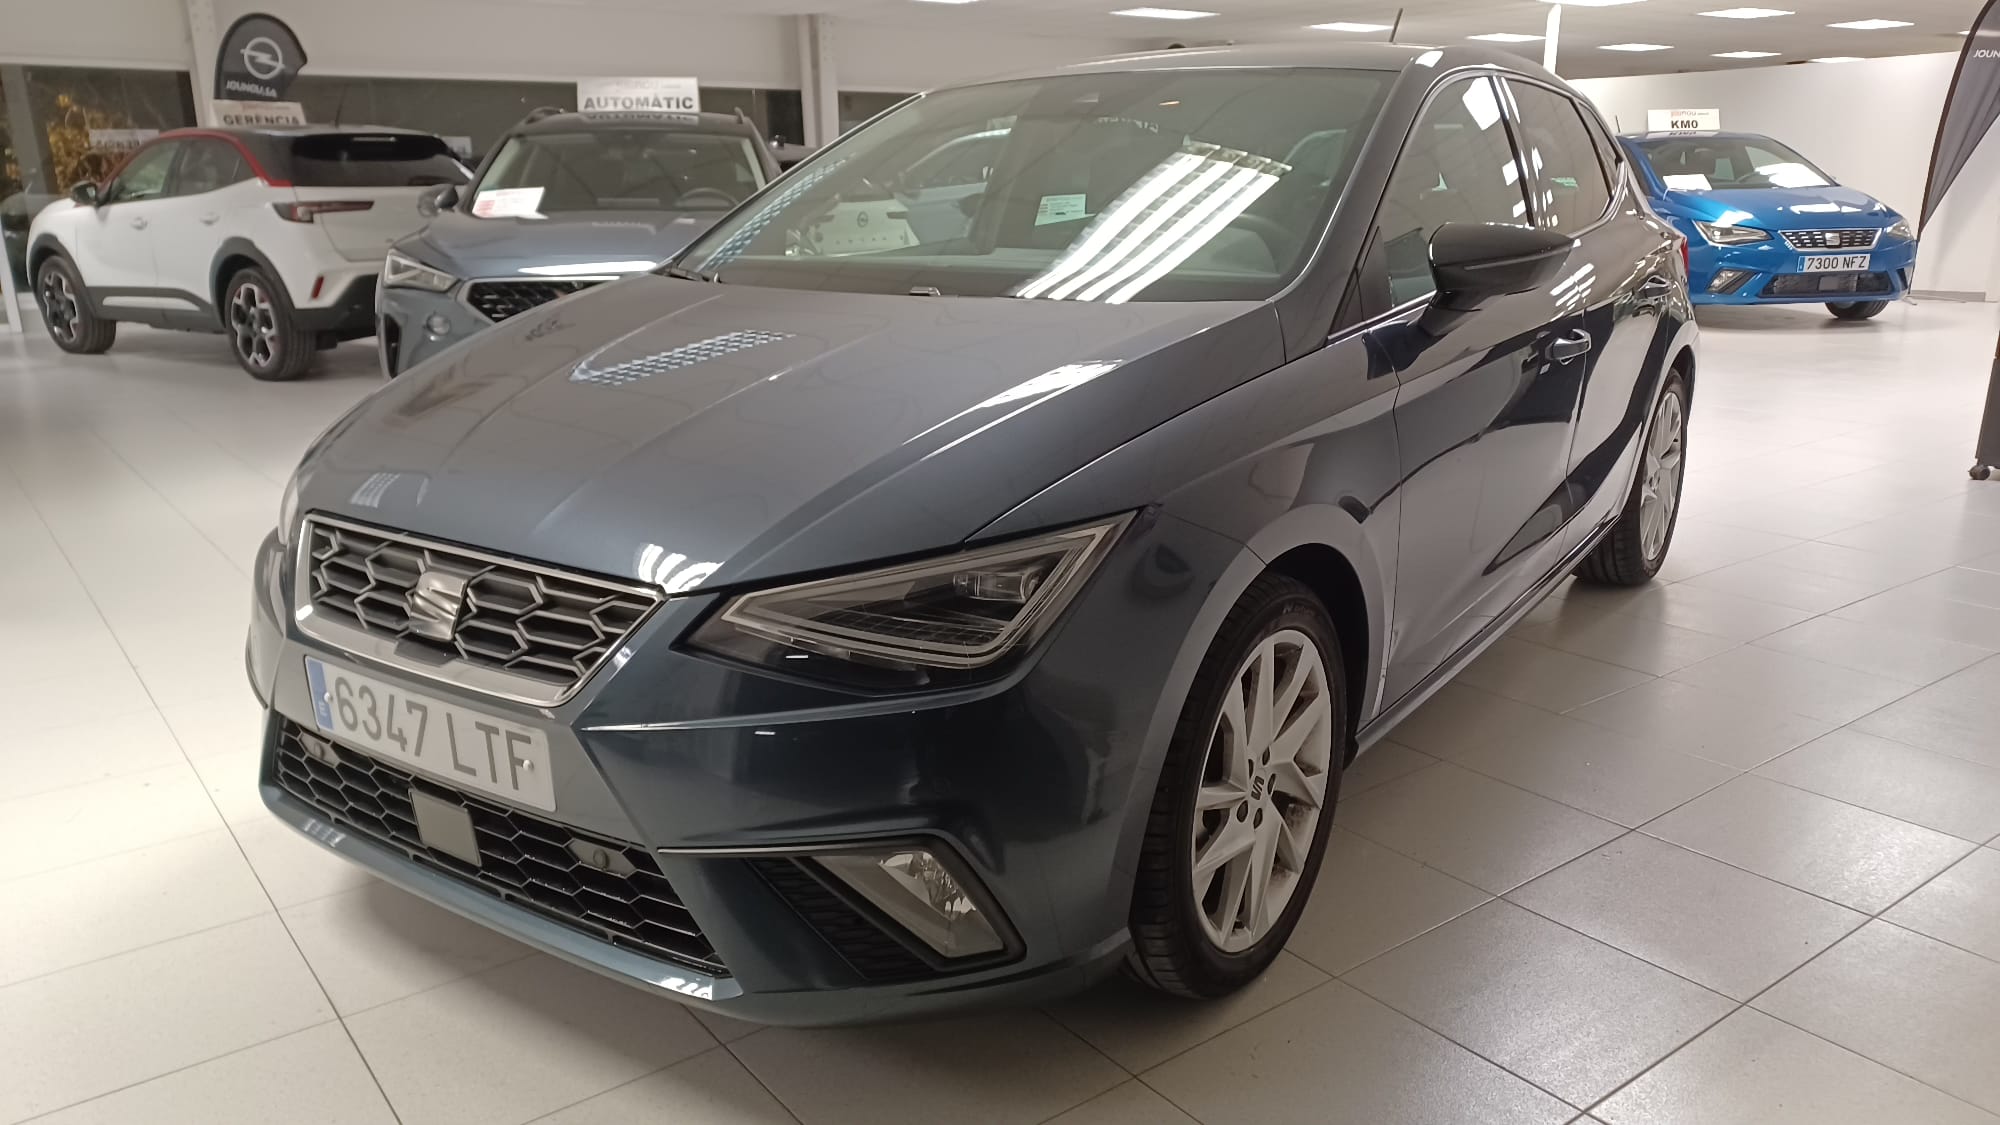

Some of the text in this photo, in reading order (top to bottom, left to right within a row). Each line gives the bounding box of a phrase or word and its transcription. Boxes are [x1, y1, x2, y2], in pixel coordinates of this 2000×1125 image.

[1807, 255, 1867, 270] 7300 NFZ
[335, 677, 532, 791] 6347 LTF
